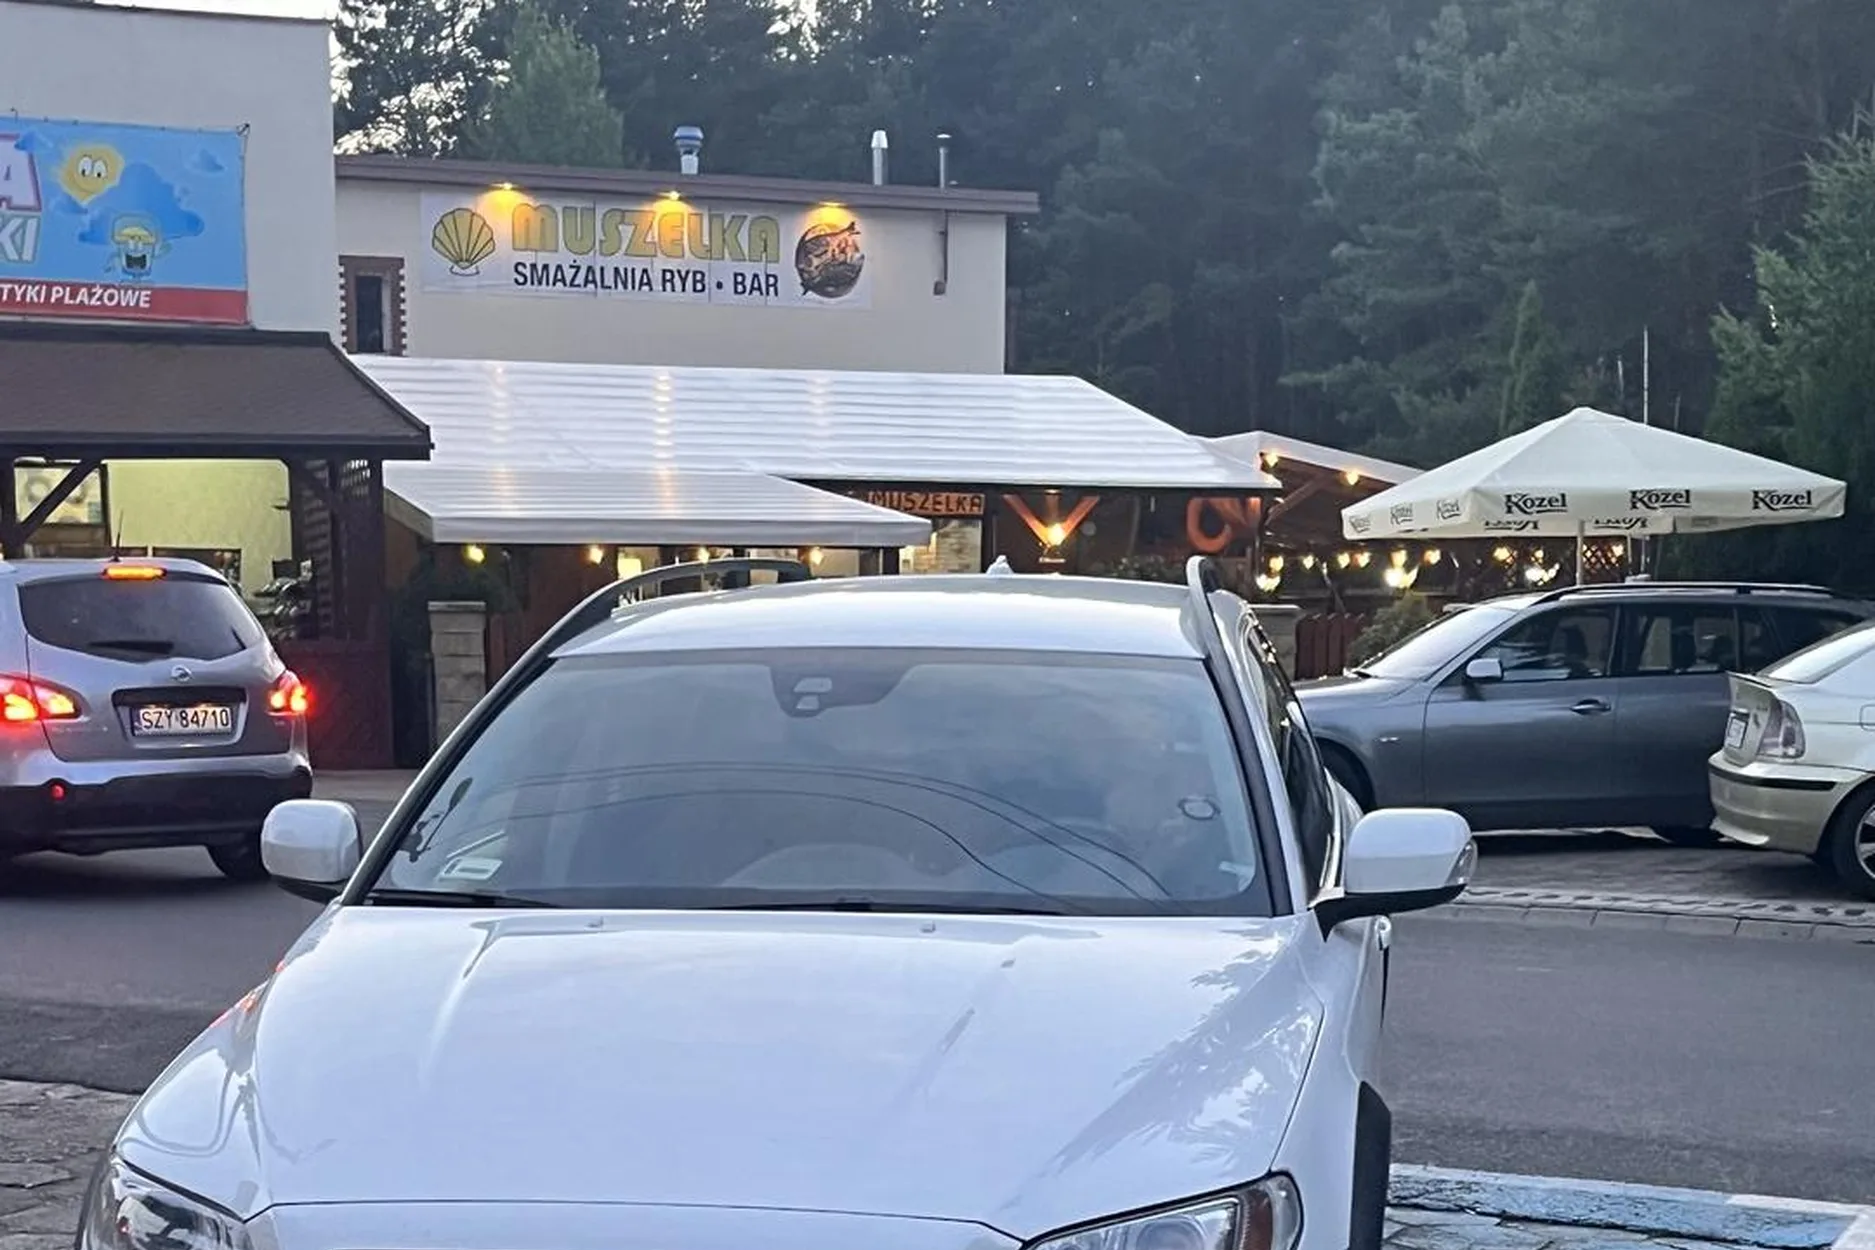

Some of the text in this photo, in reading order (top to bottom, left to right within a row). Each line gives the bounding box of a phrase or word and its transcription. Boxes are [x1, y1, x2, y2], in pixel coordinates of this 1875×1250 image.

[512, 203, 780, 263] MUSZELKA
[513, 260, 778, 297] SMAŻALNIA RYB BAR
[51, 285, 151, 308] PLAŻOWE
[1504, 493, 1568, 515] Kozel
[1630, 489, 1691, 511] Kozel
[1752, 489, 1813, 511] Kozel
[142, 710, 173, 729] SZY
[180, 708, 229, 729] 84710
